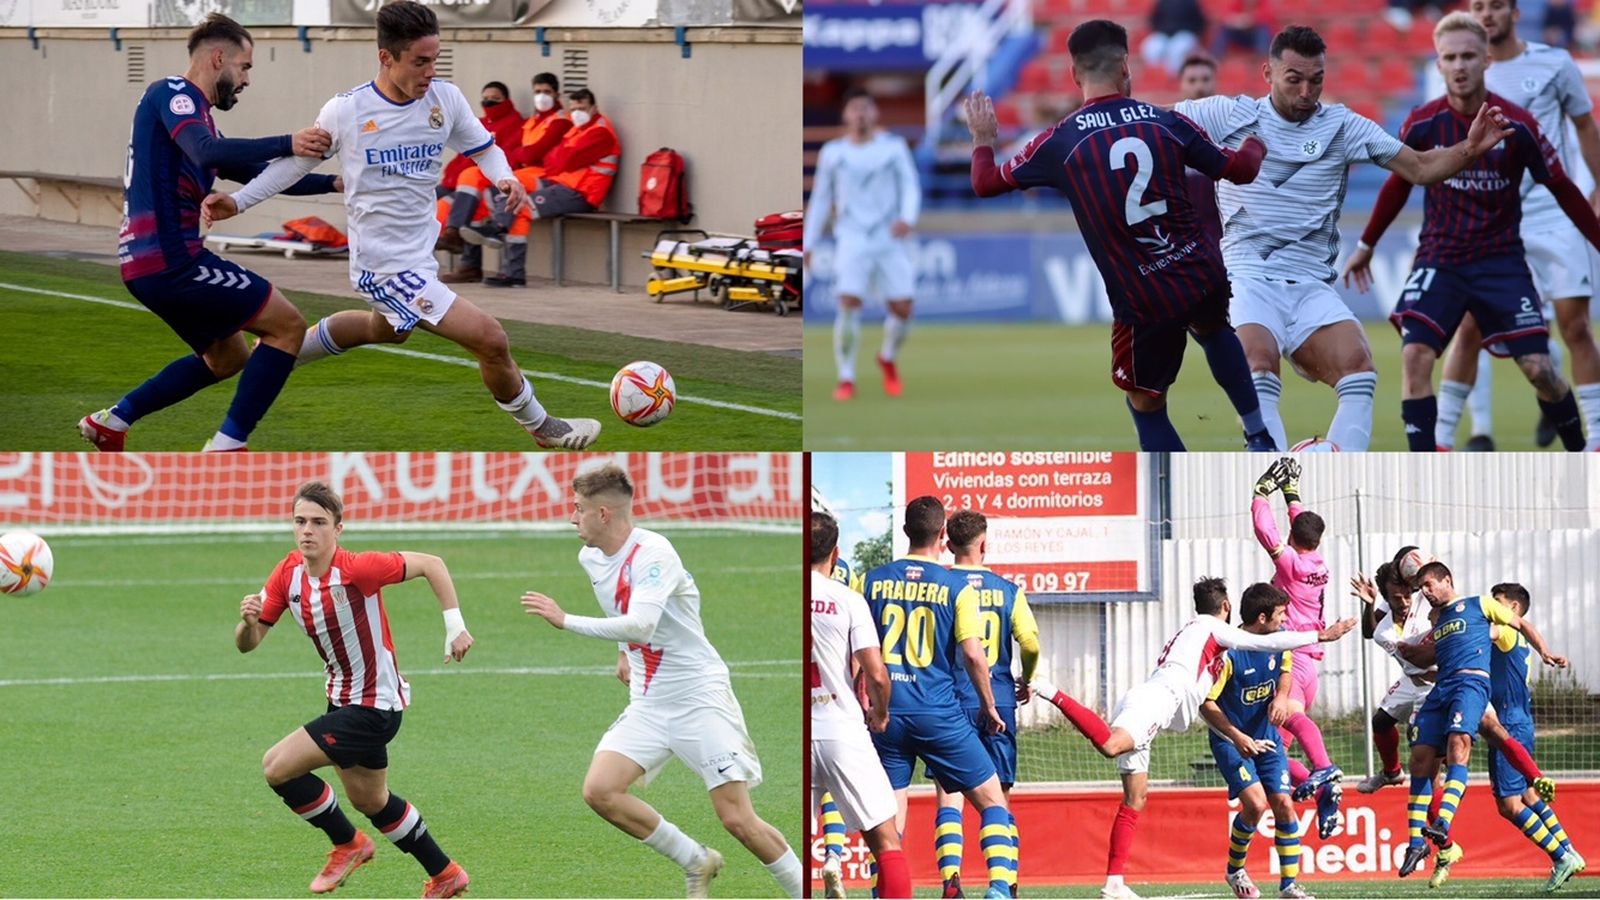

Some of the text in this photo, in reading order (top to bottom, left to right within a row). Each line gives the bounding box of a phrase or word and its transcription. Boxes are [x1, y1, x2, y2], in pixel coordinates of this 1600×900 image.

[365, 142, 444, 165] Emirates
[1109, 136, 1168, 226] 2
[386, 270, 427, 303] 10
[1405, 268, 1437, 292] 21
[933, 452, 1112, 467] Edificio sostenible
[933, 472, 1112, 489] Viviendas con terraza
[944, 492, 1103, 511] 2, 3 Y 4 dormitorios
[995, 525, 1041, 539] RAMÓN
[1025, 541, 1064, 553] REYES
[1032, 573, 1062, 591] 09
[1066, 572, 1090, 591] 97
[871, 580, 949, 606] PRADERA
[977, 589, 1004, 607] BU
[811, 600, 839, 615] DA
[882, 604, 935, 667] 20
[1238, 766, 1251, 782] 4
